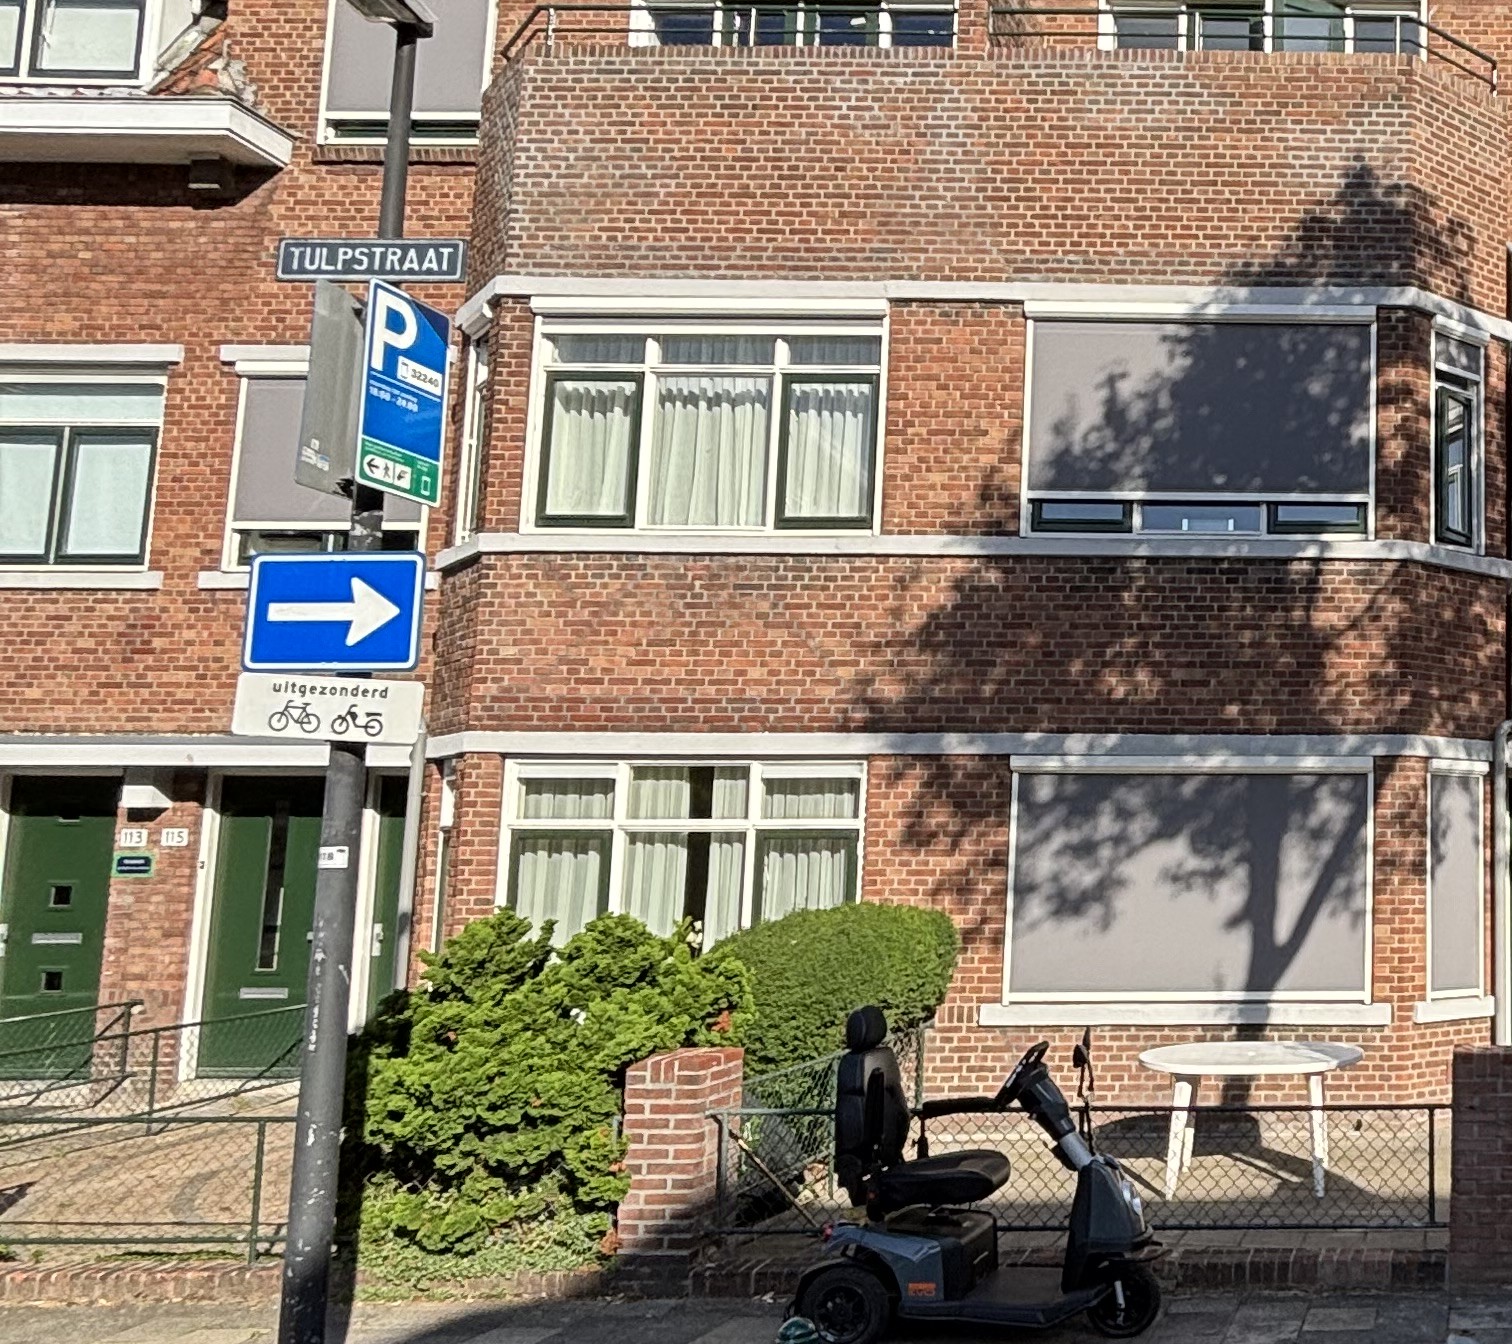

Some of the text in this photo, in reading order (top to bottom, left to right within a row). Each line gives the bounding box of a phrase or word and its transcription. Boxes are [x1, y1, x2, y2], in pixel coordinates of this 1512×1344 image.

[289, 247, 454, 272] TULPSTRAAT
[370, 288, 418, 372] P
[411, 368, 439, 388] 32240
[272, 681, 389, 699] uitgezonderd
[124, 830, 143, 844] 113
[165, 830, 185, 844] 115
